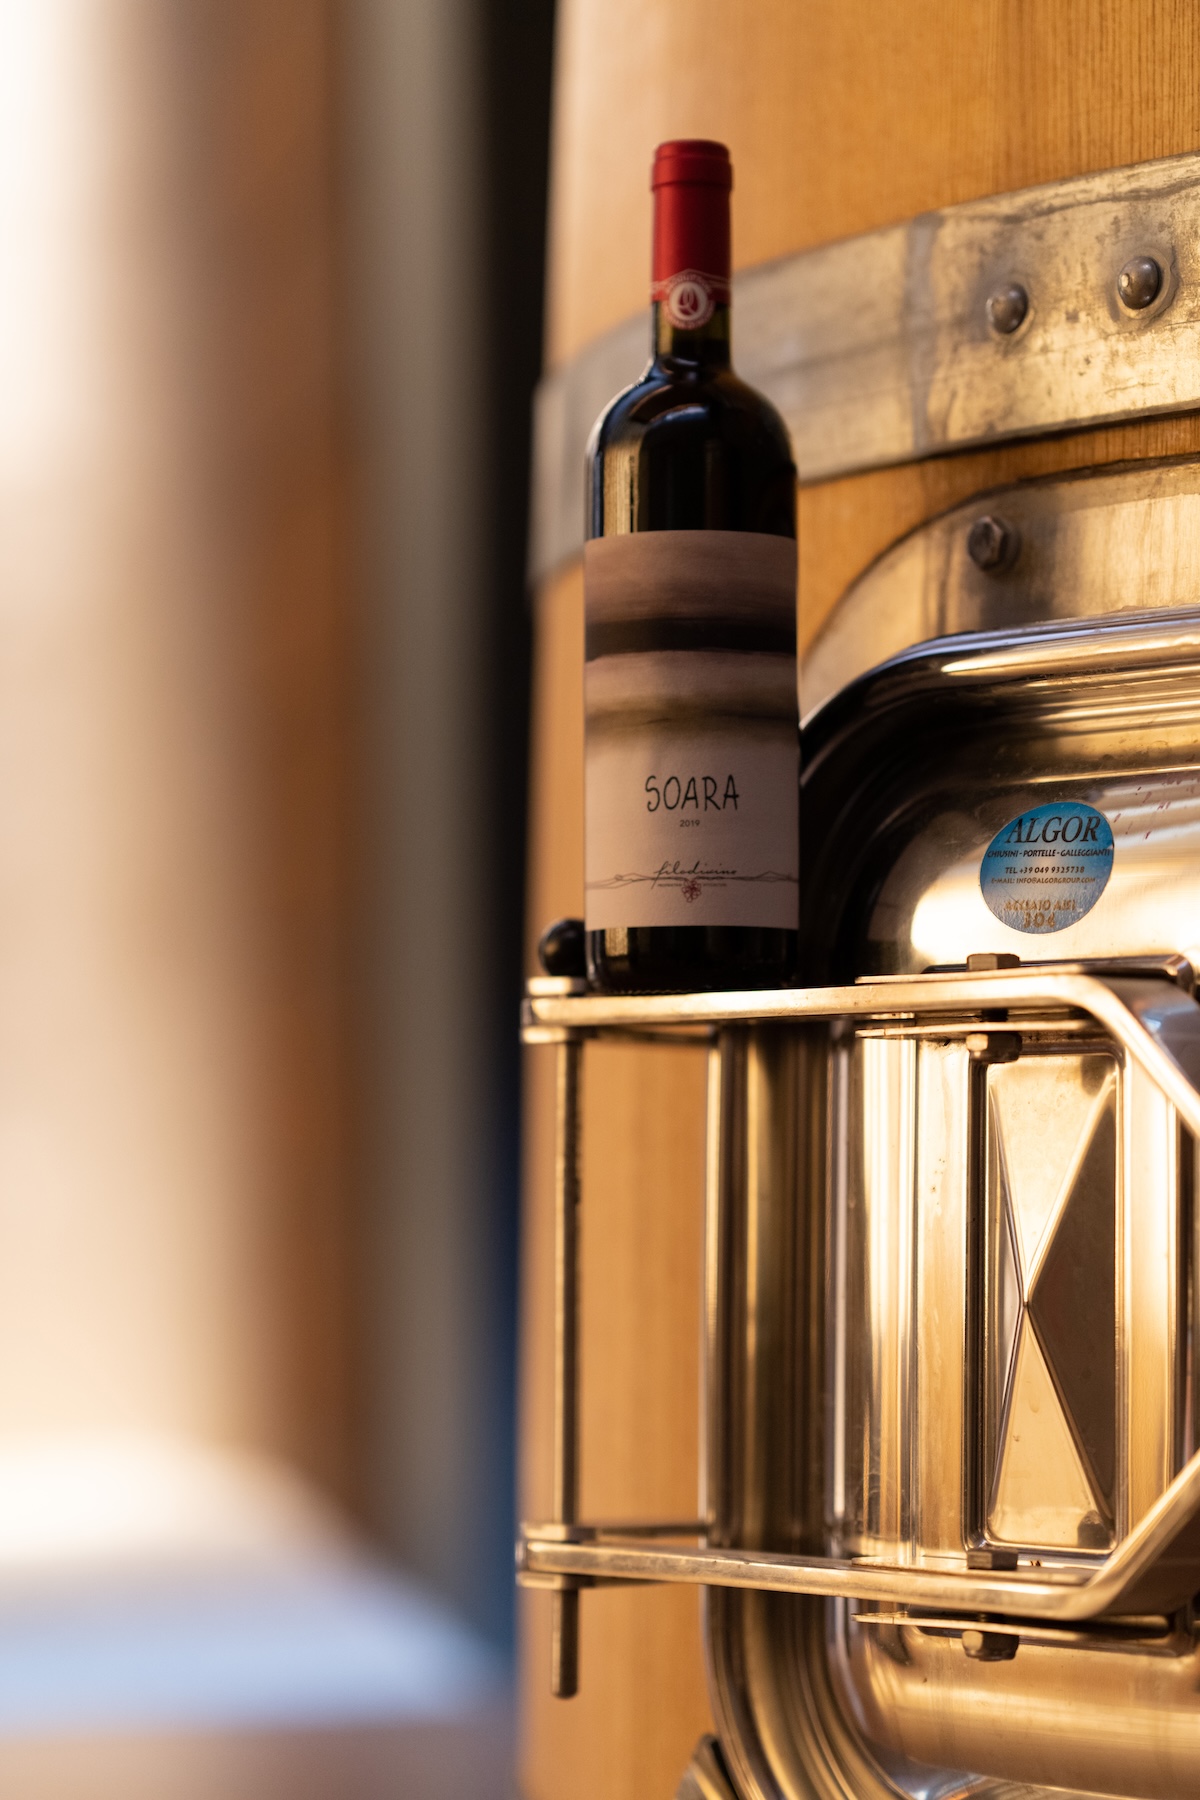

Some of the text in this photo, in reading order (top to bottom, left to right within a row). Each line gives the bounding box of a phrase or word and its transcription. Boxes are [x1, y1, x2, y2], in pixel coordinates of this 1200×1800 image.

[645, 774, 740, 812] SOARA
[679, 819, 701, 828] 2019
[1006, 816, 1100, 843] ALGOR
[987, 849, 1018, 858] CHIUSINI
[1023, 849, 1056, 857] PORTELLE
[1060, 848, 1111, 857] GALLEGGIANTI
[1034, 866, 1049, 874] 049
[1051, 866, 1085, 874] 9325738
